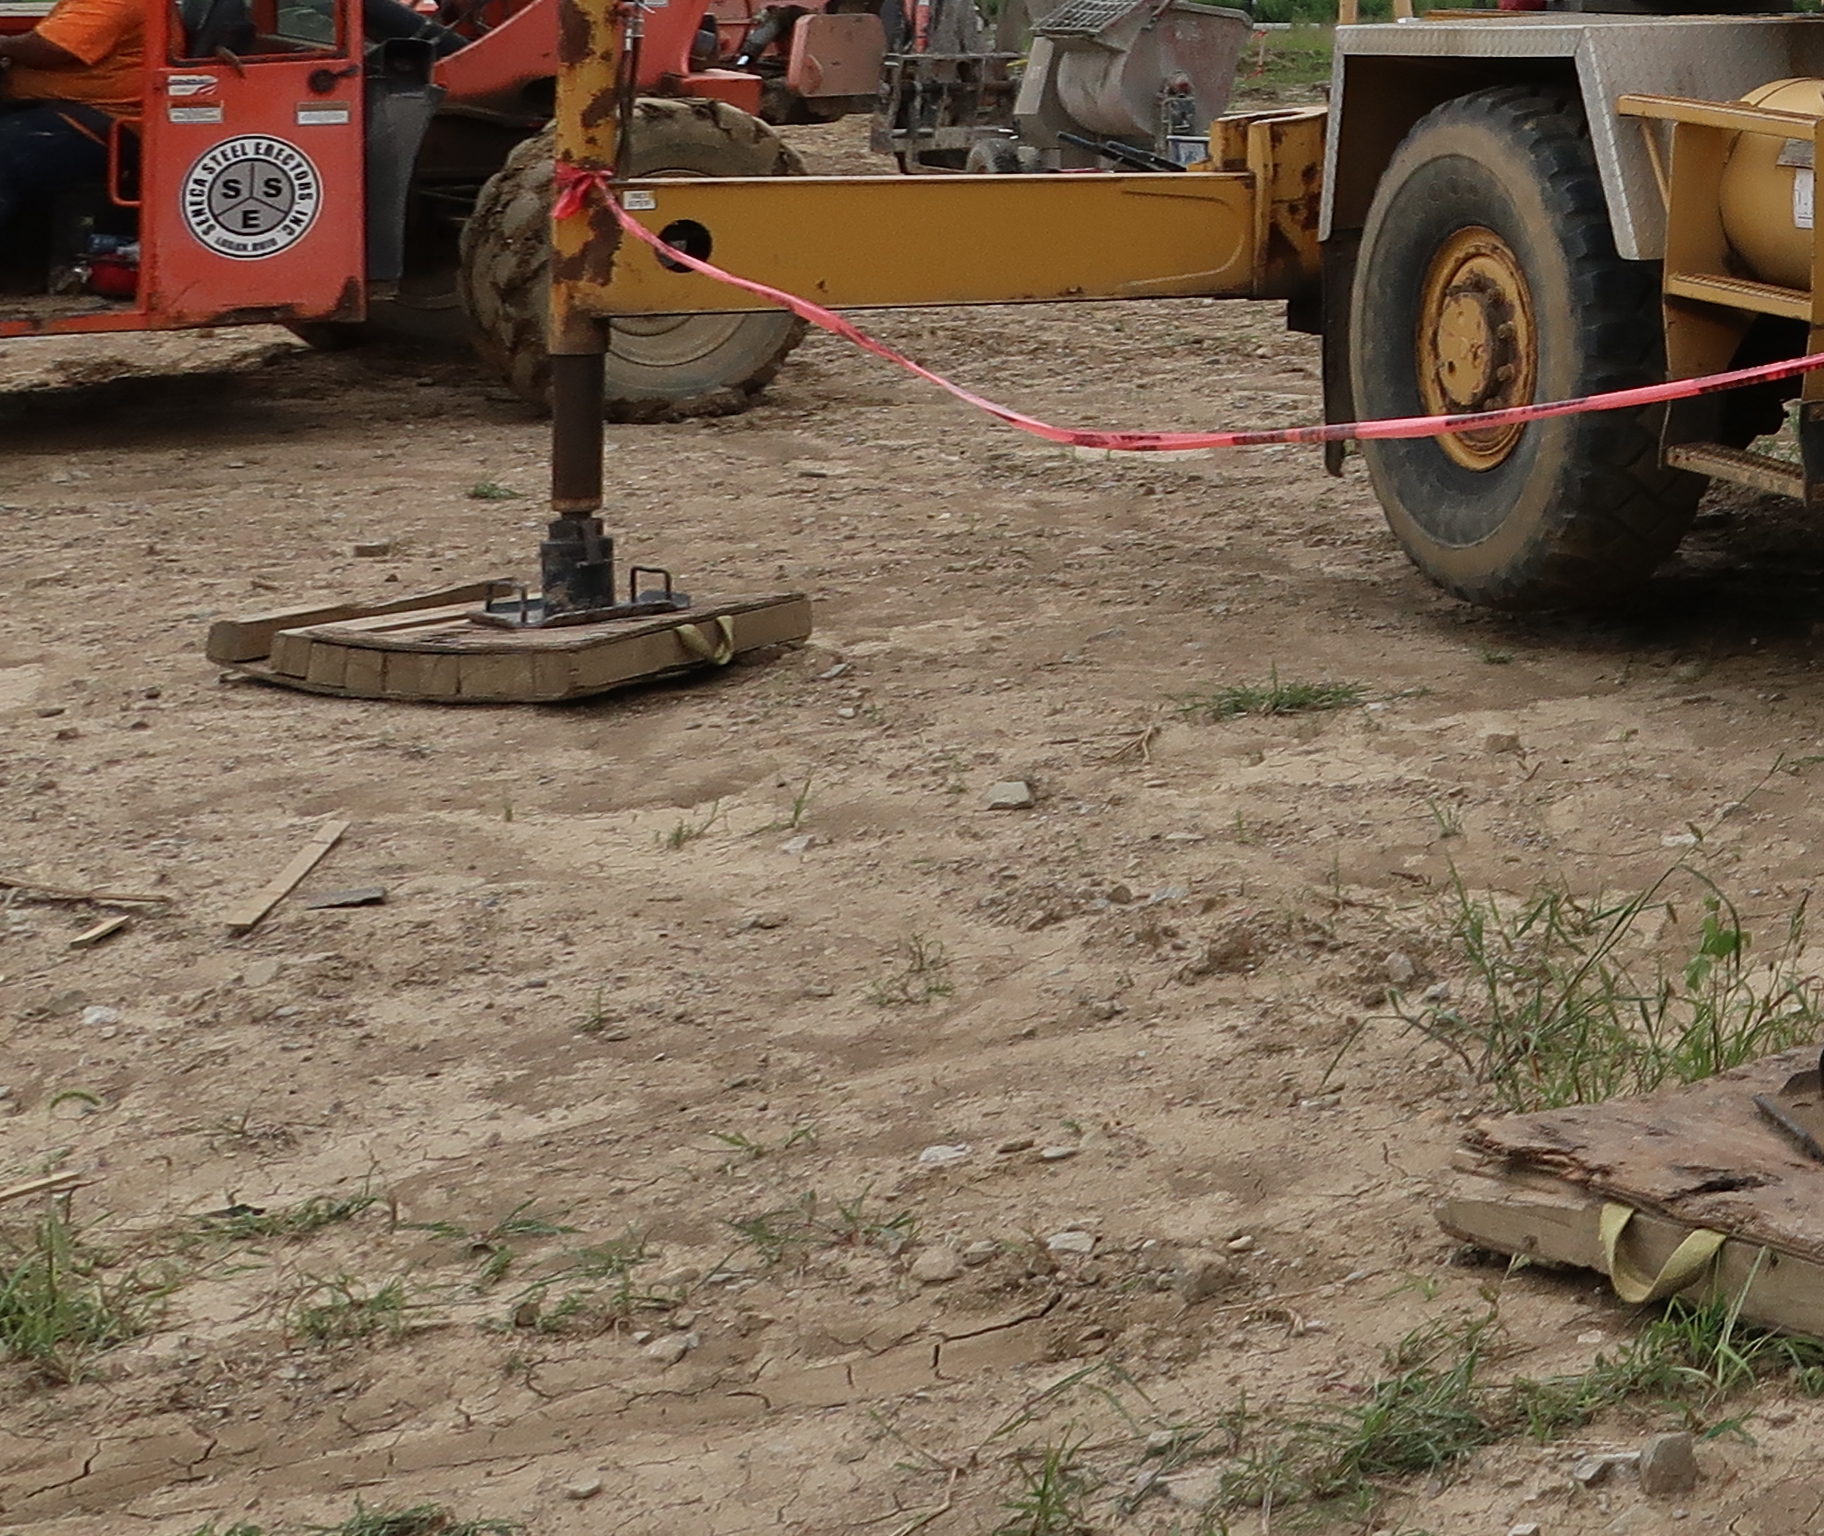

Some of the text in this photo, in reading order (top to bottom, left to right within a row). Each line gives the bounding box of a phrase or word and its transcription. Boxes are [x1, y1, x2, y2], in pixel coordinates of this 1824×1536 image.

[202, 142, 249, 175] STEEL
[221, 178, 283, 199] S S
[242, 209, 261, 229] E
